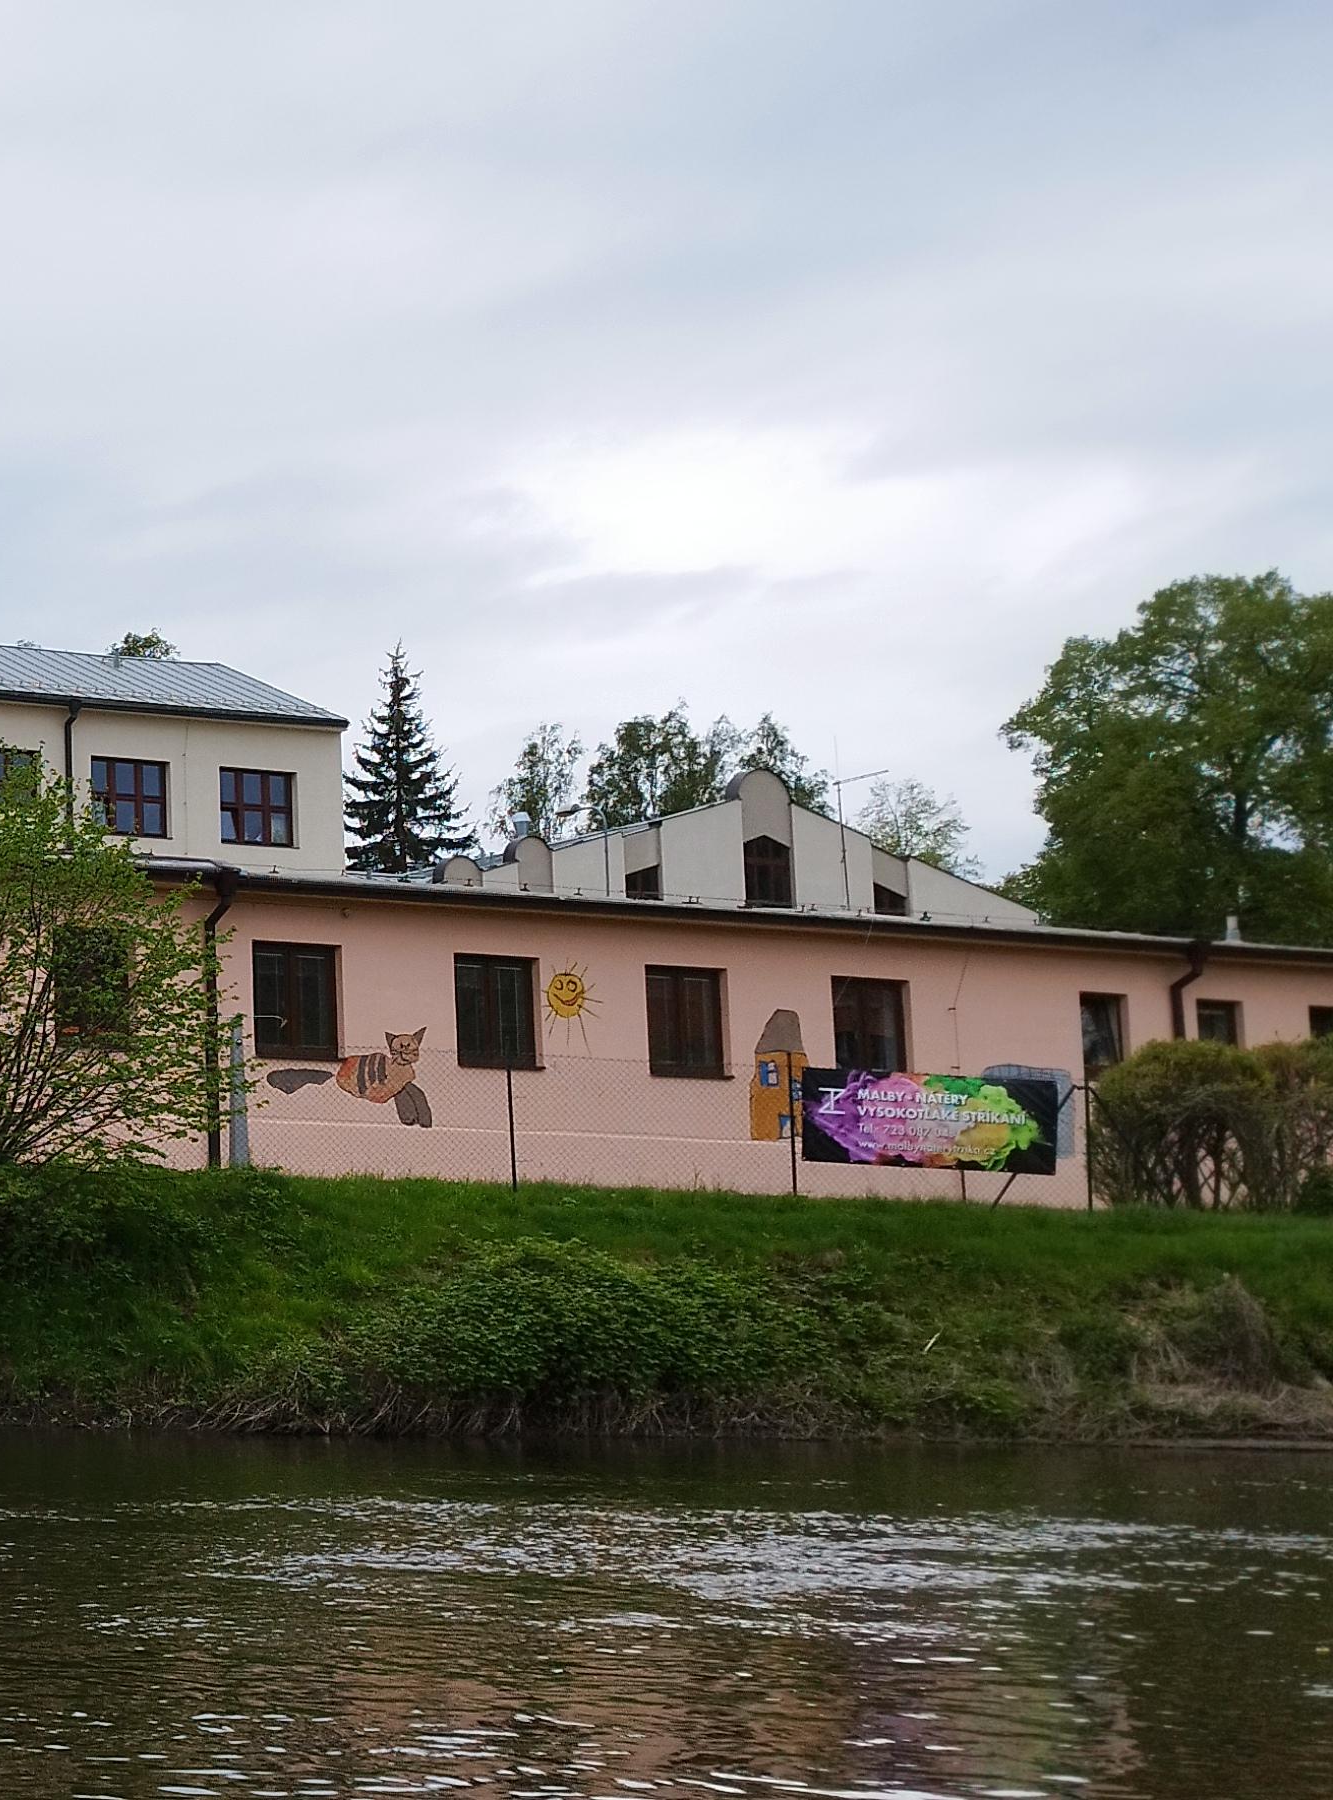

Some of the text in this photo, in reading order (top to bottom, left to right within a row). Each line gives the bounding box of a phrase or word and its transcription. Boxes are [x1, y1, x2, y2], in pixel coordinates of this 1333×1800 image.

[857, 1088, 906, 1102] MALBY
[857, 1105, 959, 1121] VYSOKOTLAKÉ
[883, 1124, 905, 1136] 723
[909, 1126, 931, 1138] 087
